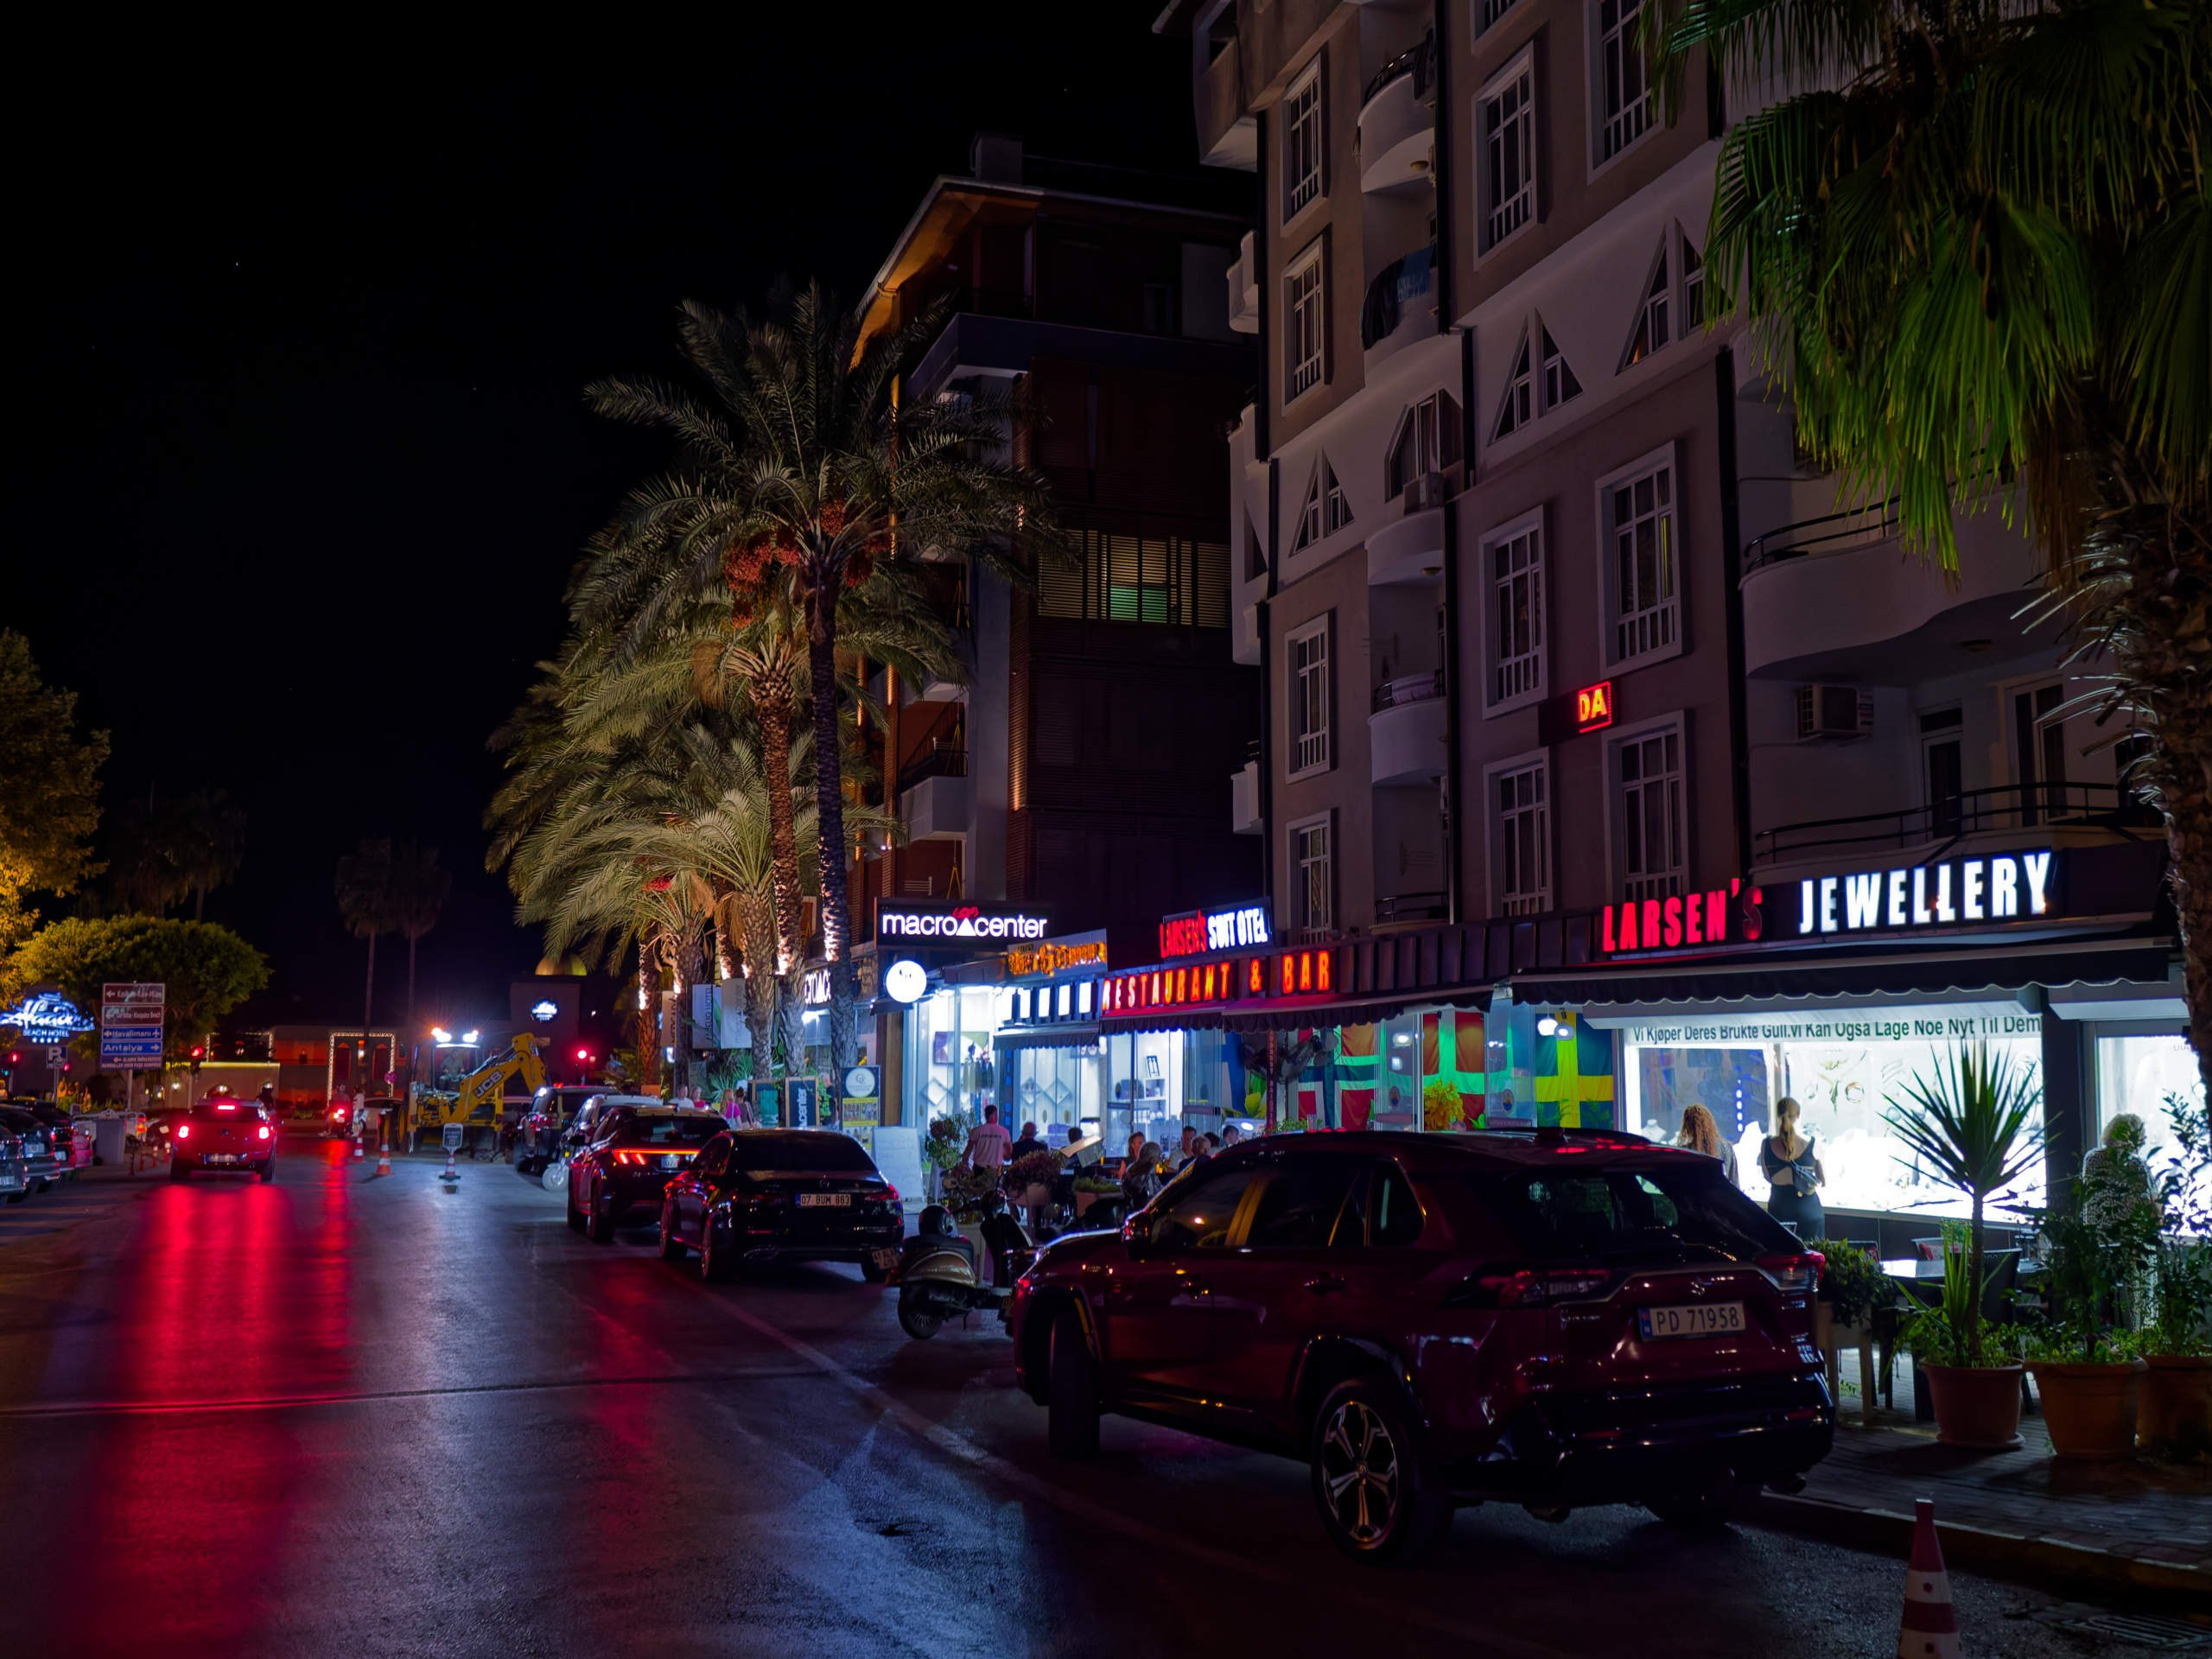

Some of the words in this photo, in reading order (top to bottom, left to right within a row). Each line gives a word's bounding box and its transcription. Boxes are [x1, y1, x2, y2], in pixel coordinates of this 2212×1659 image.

[1579, 688, 1607, 722] DA
[1603, 878, 1764, 952] LARSEN'S
[1799, 852, 2050, 934] JEWELLERY
[882, 914, 958, 936] macro
[974, 914, 1047, 938] center
[1102, 962, 1230, 1010] RESTAURANT
[1251, 959, 1262, 992] &
[1283, 950, 1330, 994] BAR
[1684, 1026, 1717, 1039] Deres
[1720, 1025, 1759, 1039] Brukte
[1806, 1022, 1831, 1037] Kan
[1875, 1021, 1910, 1040] Lage
[1915, 1020, 1943, 1035] Noe
[1948, 1018, 1974, 1038] Nyt
[2004, 1016, 2041, 1033] Dem
[476, 1071, 503, 1097] JCB
[1656, 1310, 1680, 1332] PD
[1687, 1306, 1739, 1331] 71958
